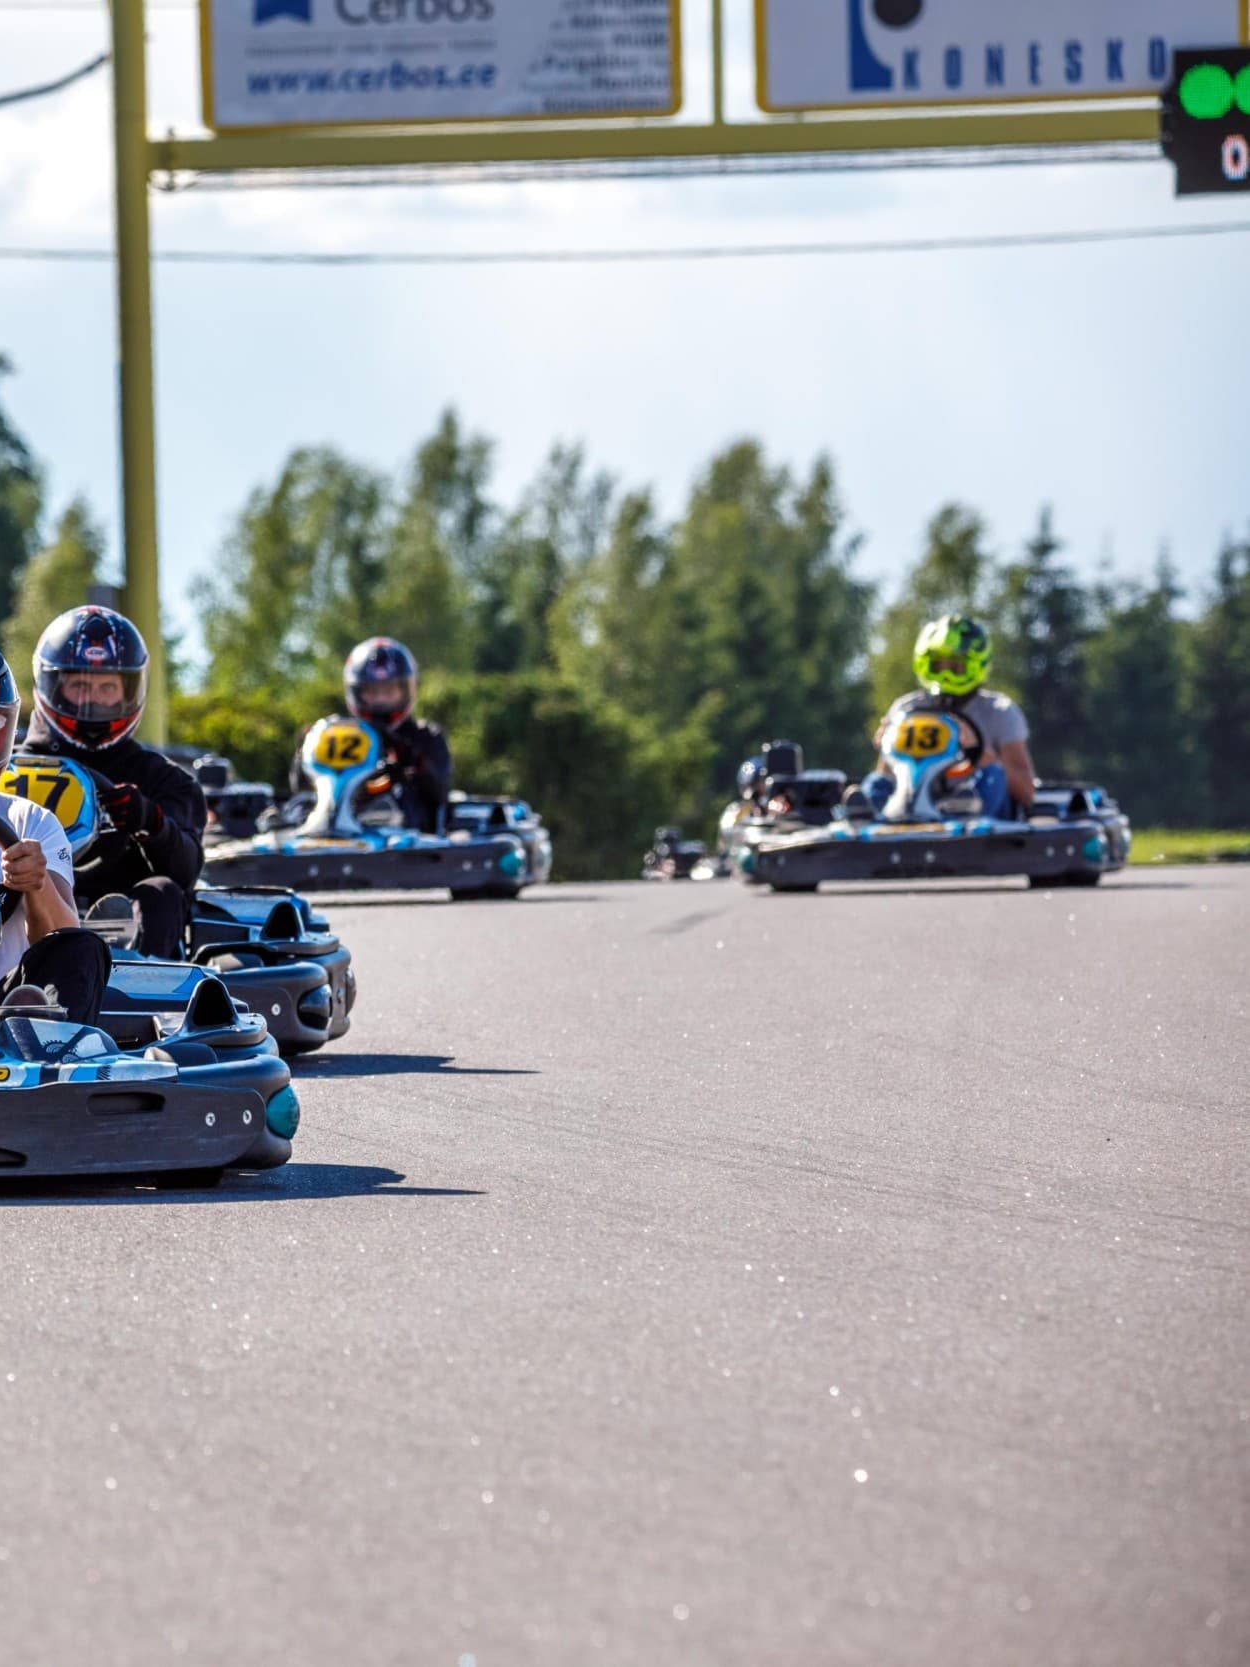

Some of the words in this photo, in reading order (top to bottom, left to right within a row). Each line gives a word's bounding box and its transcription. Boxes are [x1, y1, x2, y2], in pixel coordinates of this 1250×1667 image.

[246, 60, 496, 95] www.cerbos.ee
[903, 36, 1166, 90] KONESKO
[1221, 134, 1247, 181] 0
[326, 735, 362, 760] 12
[905, 726, 940, 750] 13
[5, 774, 70, 815] 17
